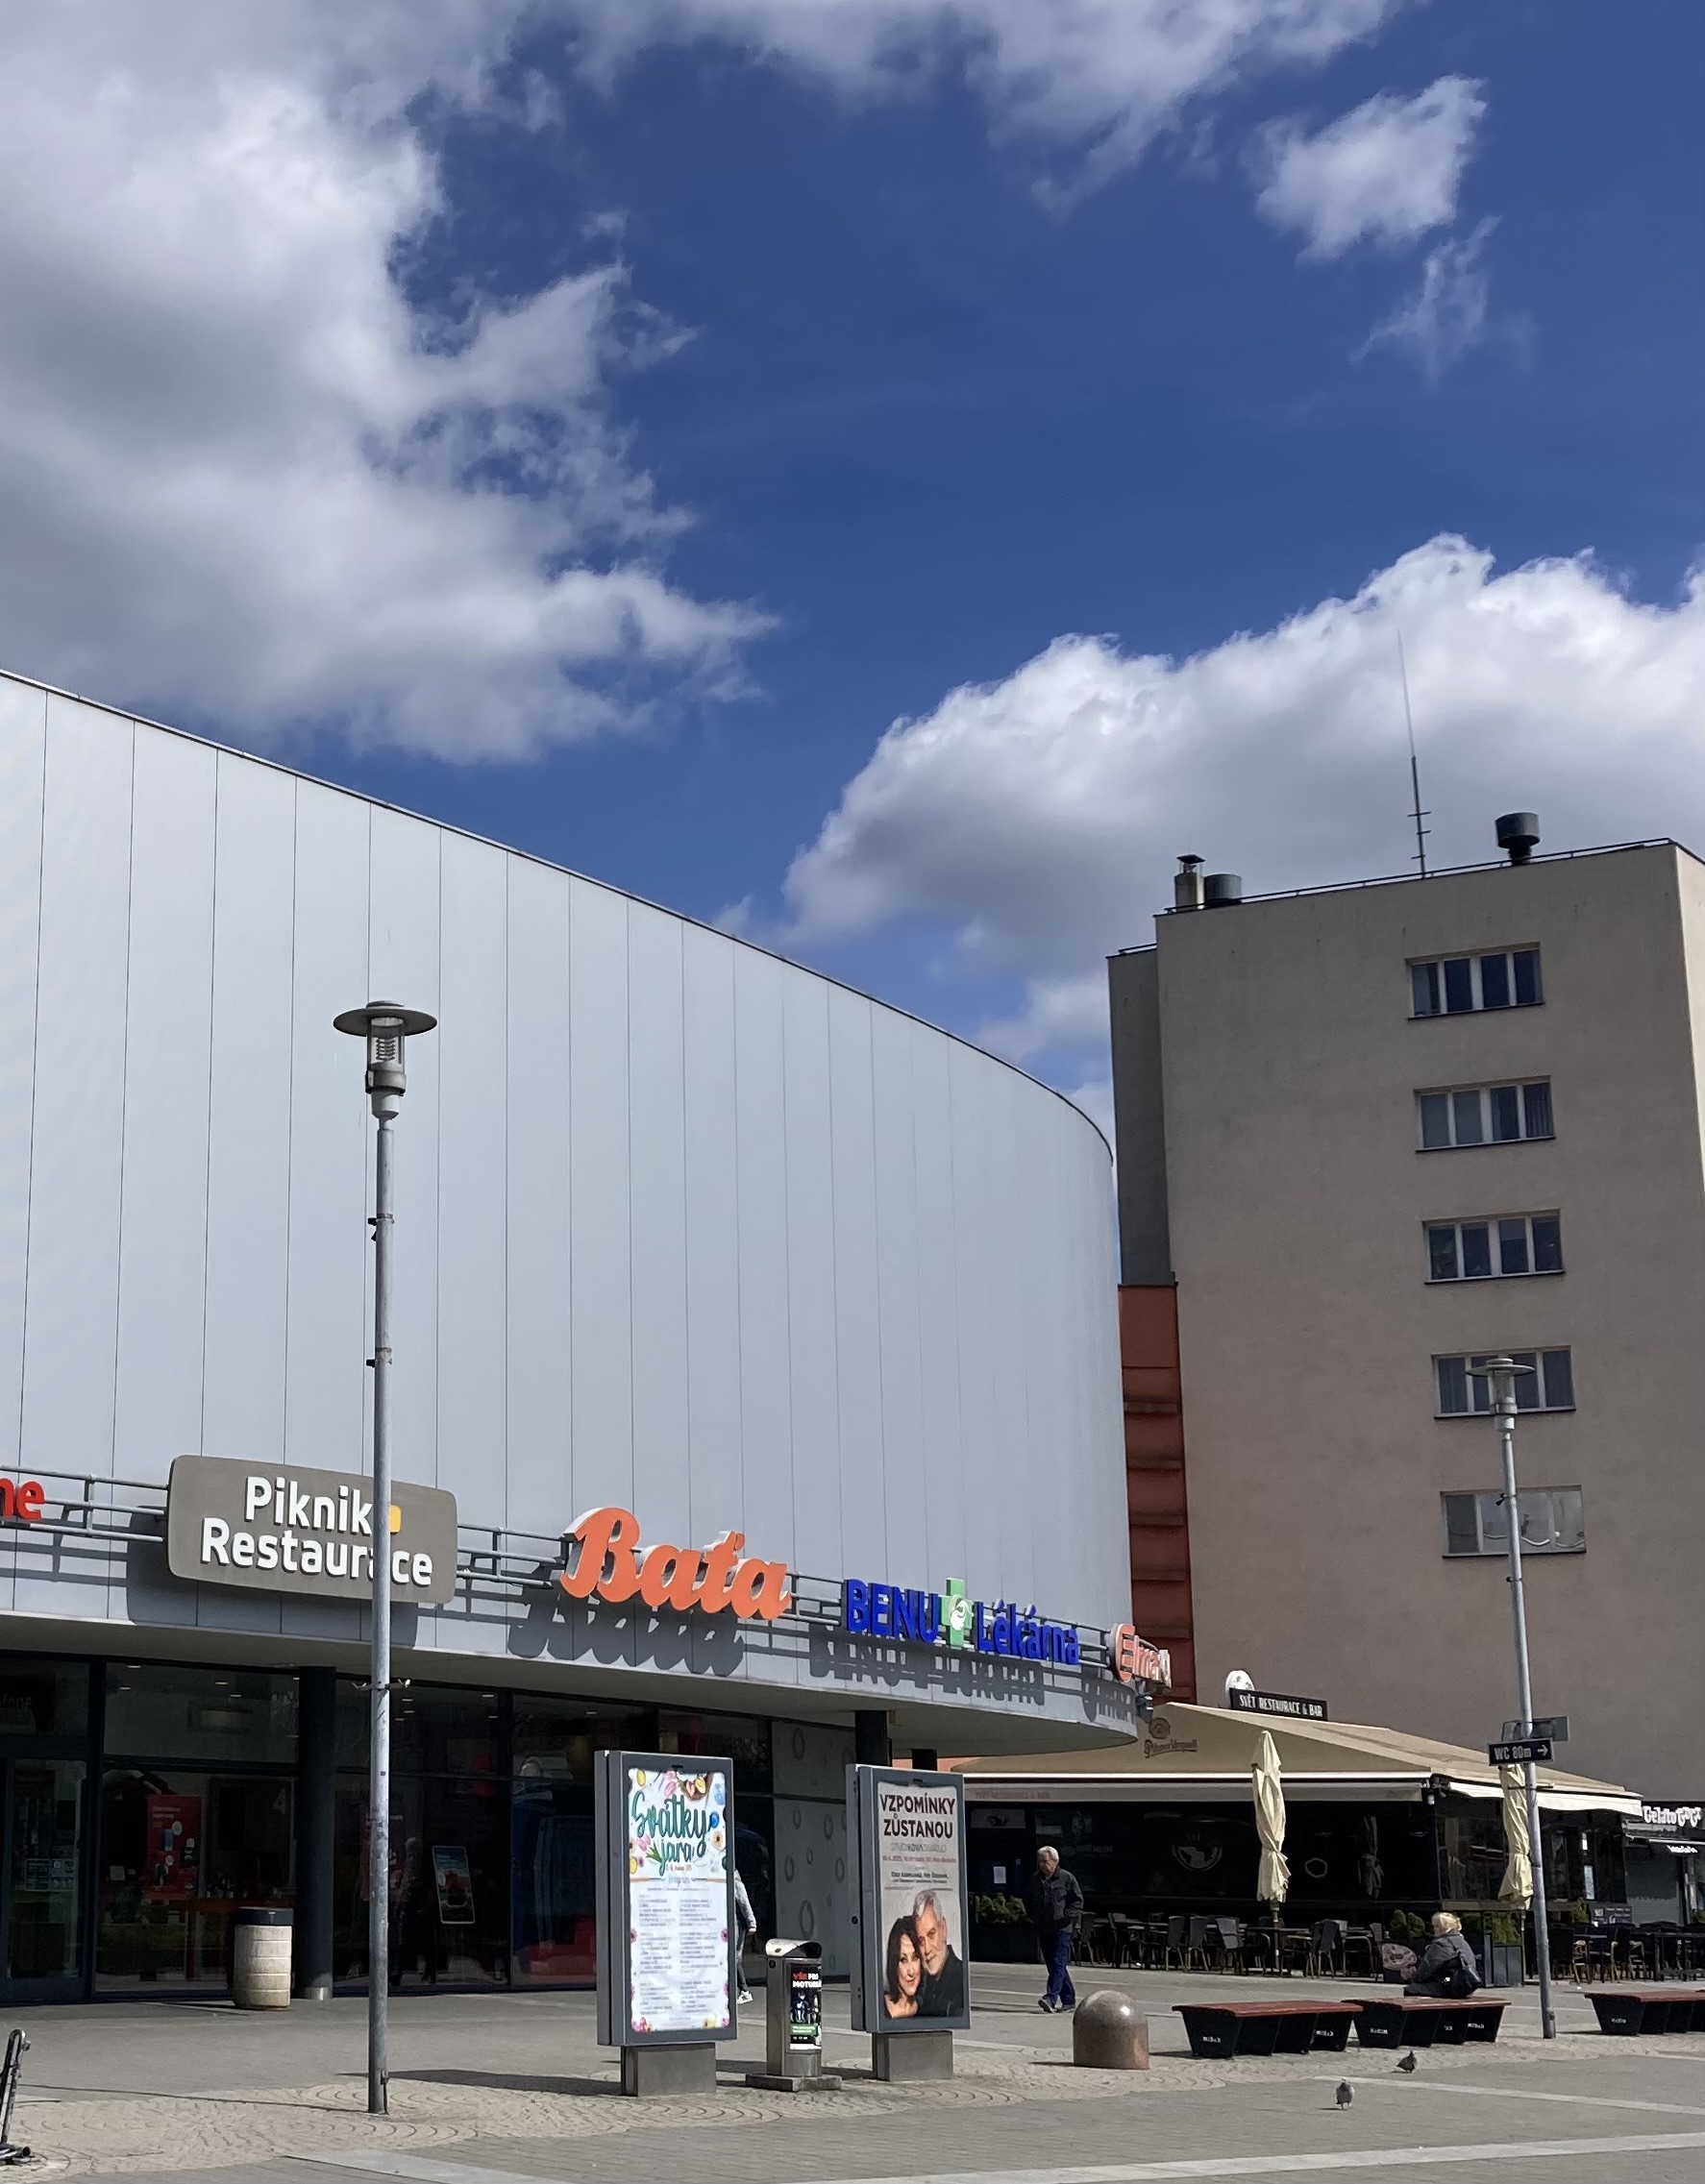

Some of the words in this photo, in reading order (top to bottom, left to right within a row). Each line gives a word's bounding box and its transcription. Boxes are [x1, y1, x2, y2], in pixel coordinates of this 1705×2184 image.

[245, 1476, 373, 1535] Piknik
[201, 1517, 432, 1585] Restaurce
[560, 1507, 792, 1620] Baťa
[844, 1579, 939, 1643] BENU
[975, 1599, 1079, 1665] Lékárna
[1239, 1693, 1256, 1708] SVĚT
[1258, 1697, 1300, 1715] RESTAURACE
[1309, 1704, 1323, 1717] BAR
[1494, 1746, 1510, 1760] WC
[1512, 1745, 1532, 1759] 80m
[631, 1790, 707, 1857] Svátky
[879, 1792, 955, 1815] VZPOMÍNKY
[1643, 1805, 1677, 1824] Gelato
[883, 1812, 953, 1839] ZŮSTANOU
